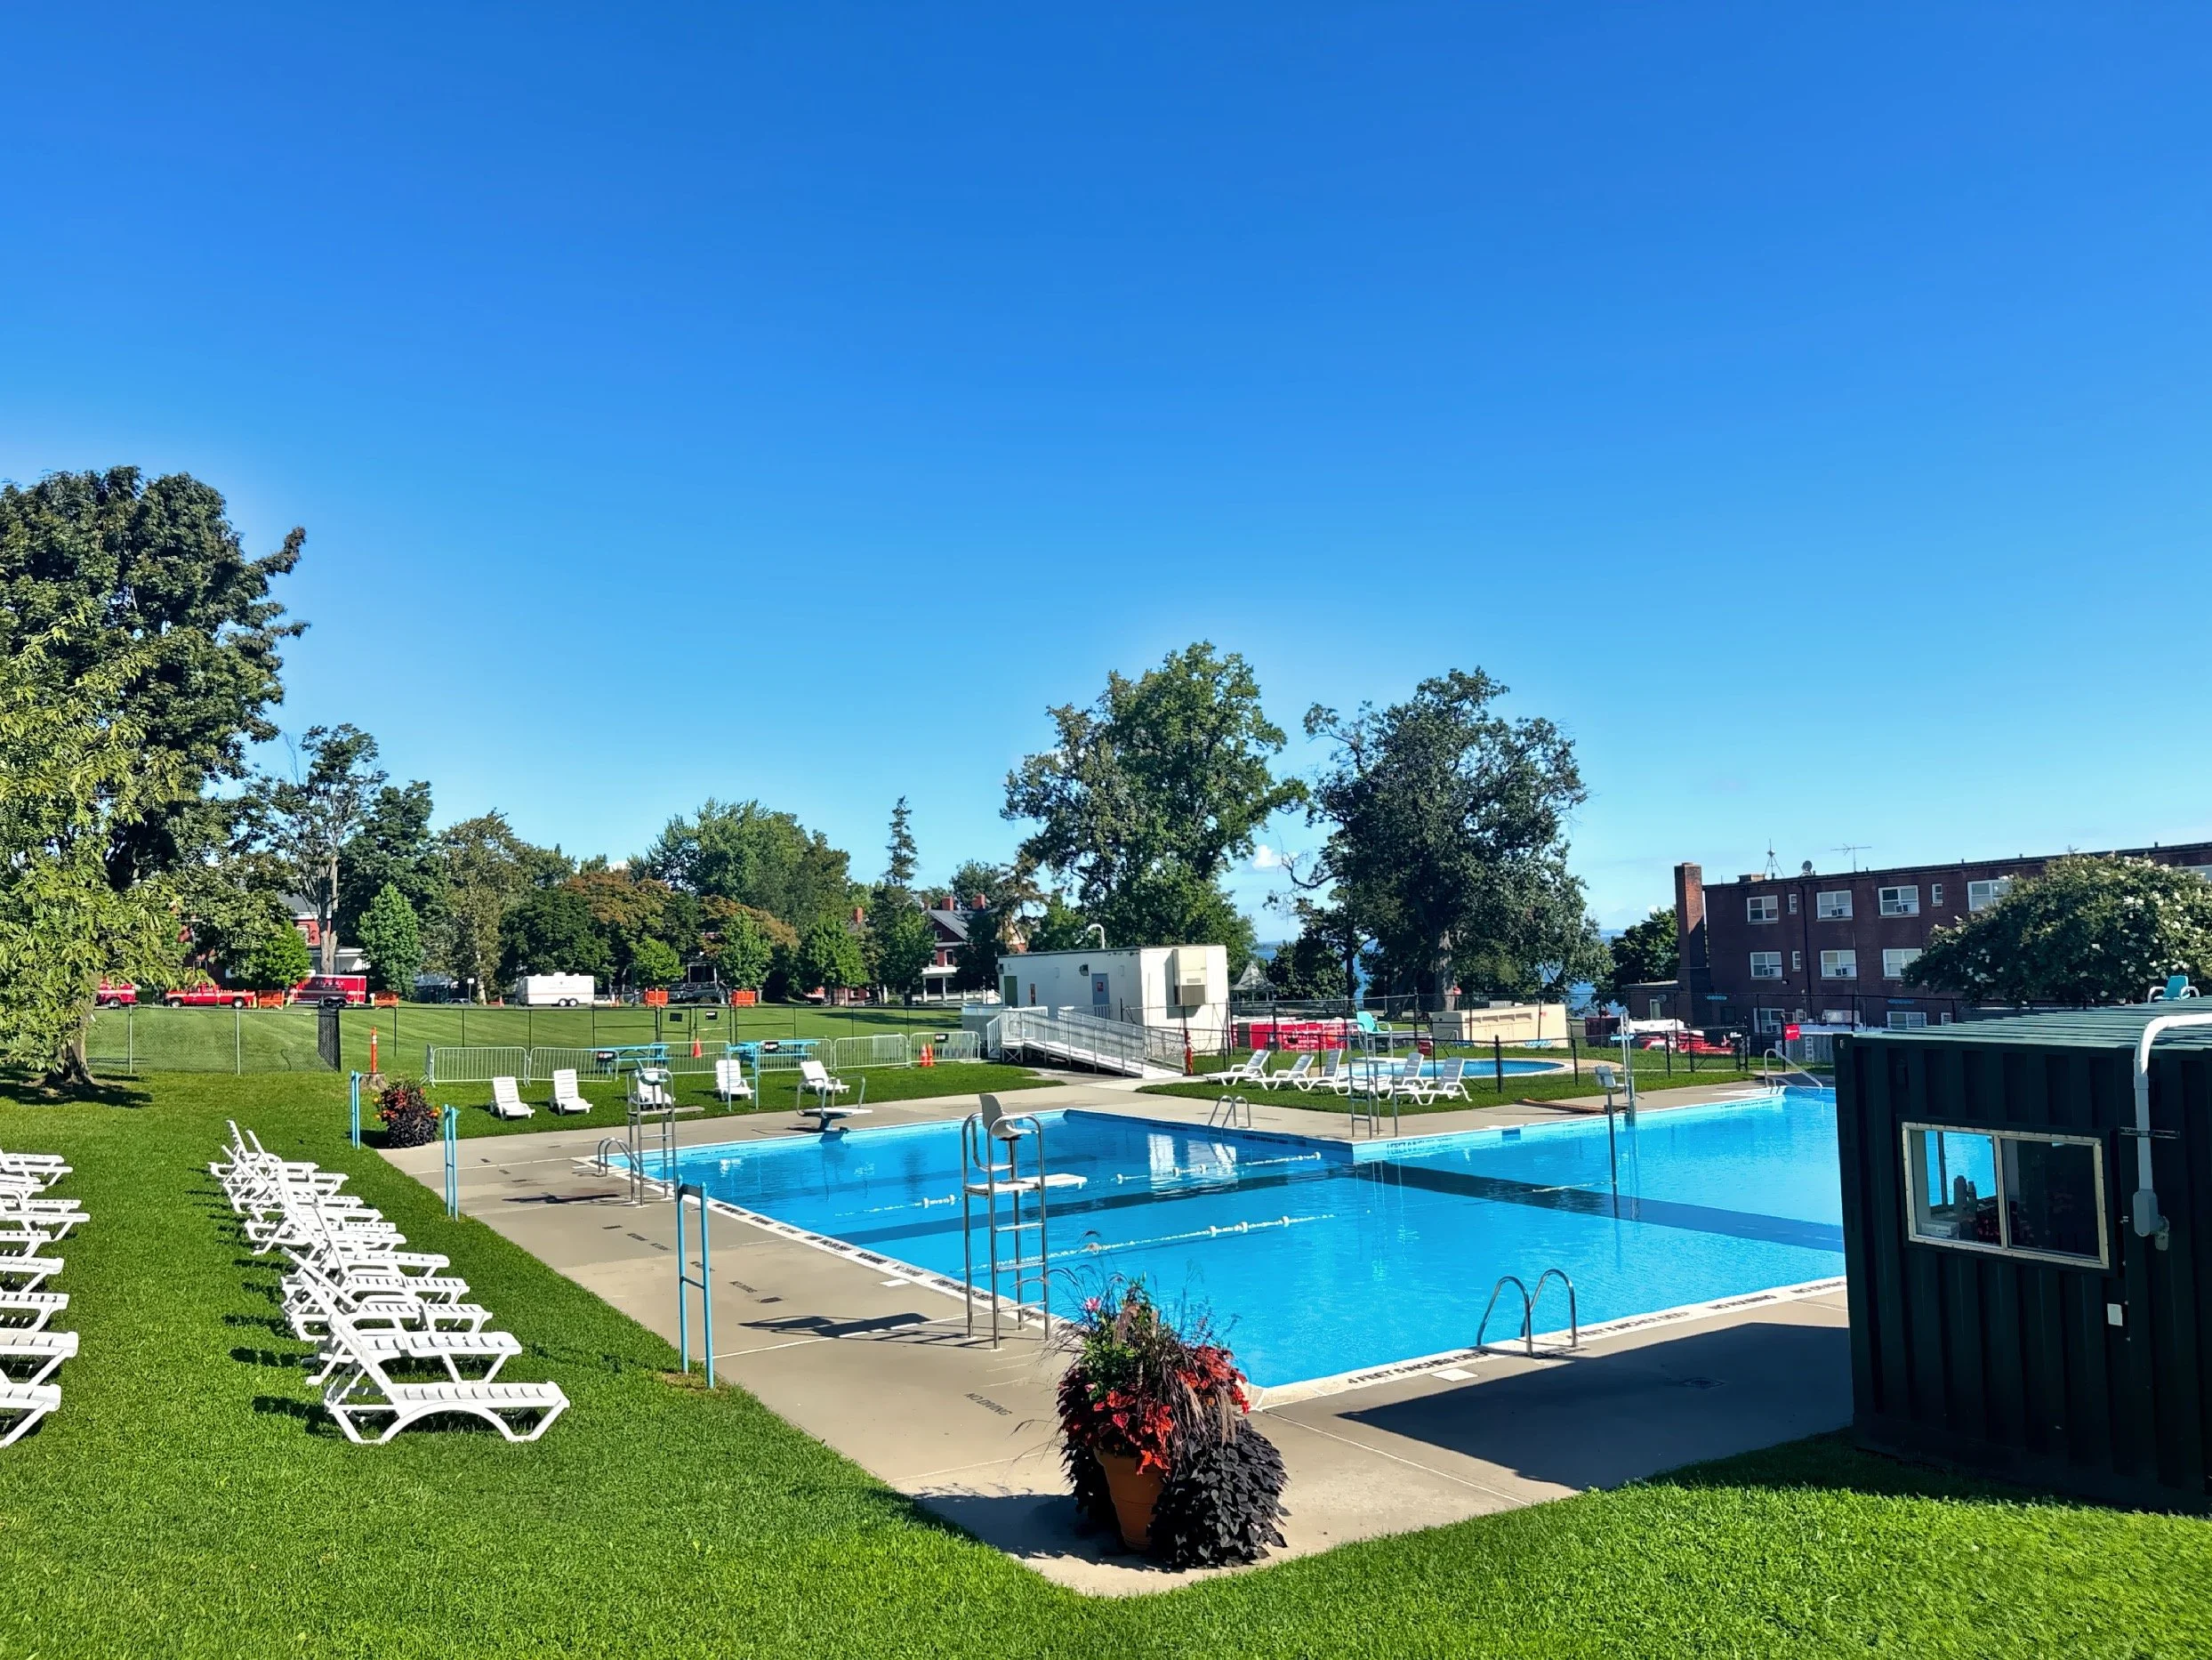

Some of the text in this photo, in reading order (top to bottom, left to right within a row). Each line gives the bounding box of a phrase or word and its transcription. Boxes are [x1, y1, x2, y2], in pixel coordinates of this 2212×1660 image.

[1356, 1370, 1394, 1382] FEET
[1404, 1358, 1457, 1371] INCHES
[1453, 1351, 1488, 1361] DEEP
[963, 1392, 1013, 1415] NO DIVING
